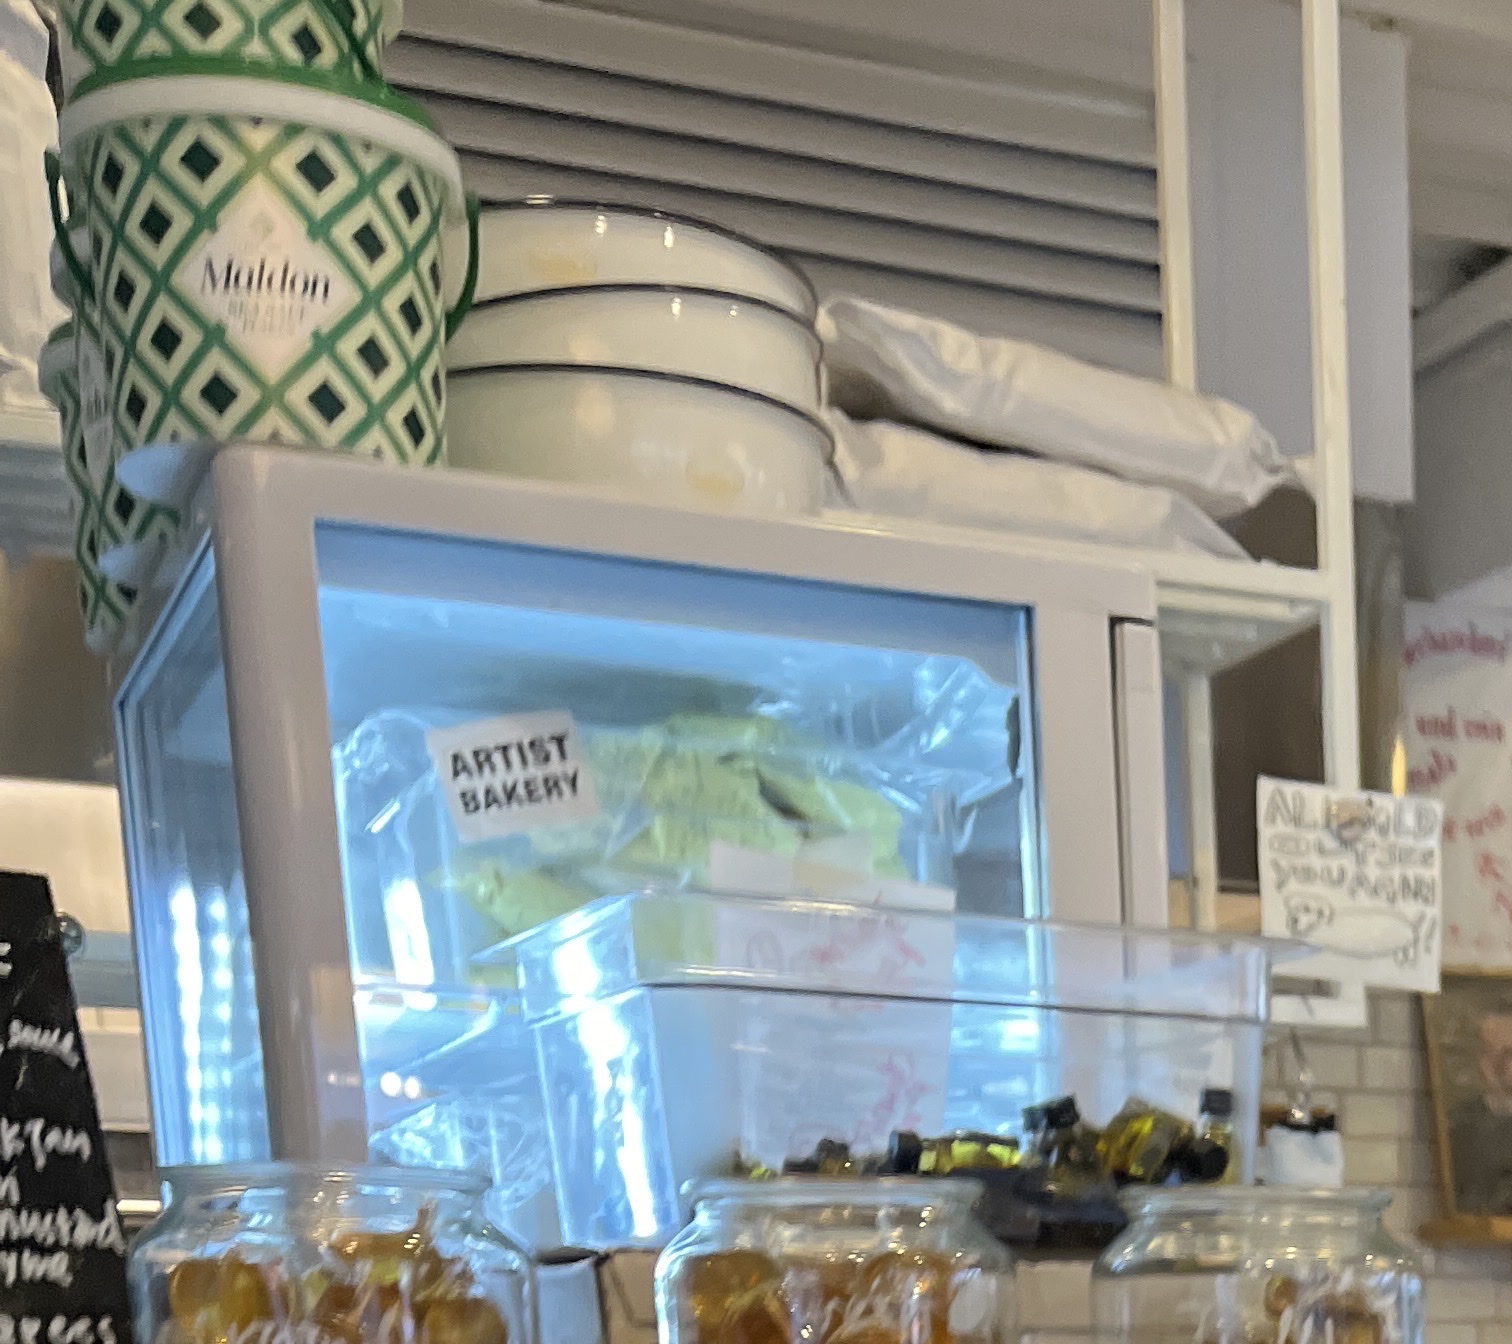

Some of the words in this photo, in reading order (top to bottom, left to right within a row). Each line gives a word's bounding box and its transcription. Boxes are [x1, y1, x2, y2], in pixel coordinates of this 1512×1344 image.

[202, 255, 331, 301] Maldon
[451, 730, 568, 780] ARTIST
[459, 768, 578, 815] BAKERY
